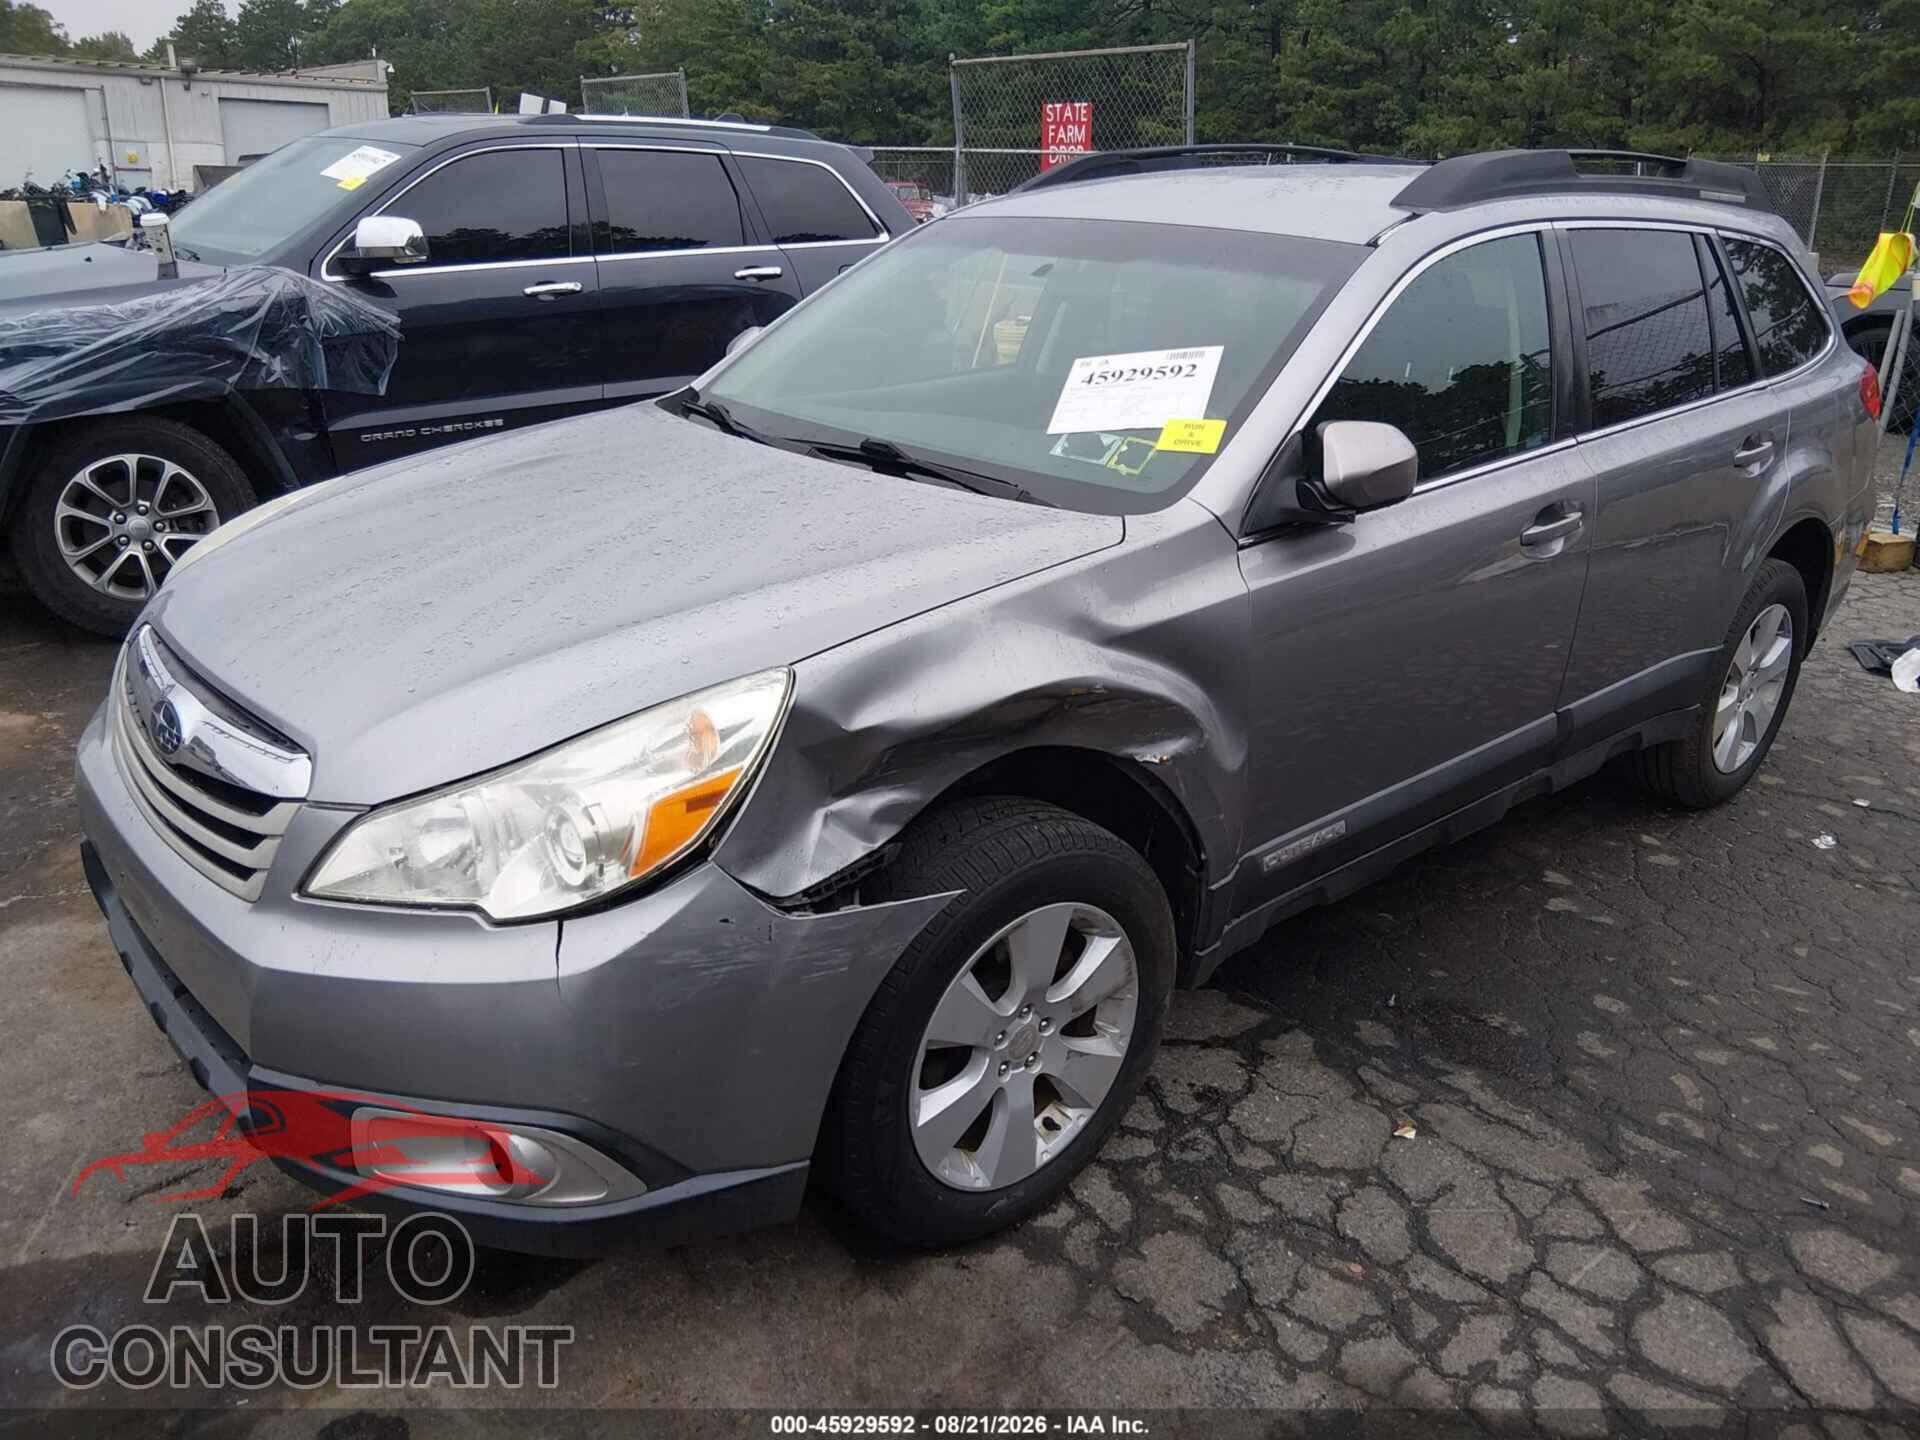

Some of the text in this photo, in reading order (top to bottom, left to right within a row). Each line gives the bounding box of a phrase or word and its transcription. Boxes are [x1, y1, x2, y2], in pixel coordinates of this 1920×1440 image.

[1046, 102, 1088, 122] STATE
[1048, 124, 1086, 143] FARM
[1081, 363, 1198, 385] 45929592
[360, 418, 504, 442] GRAND CHEROKEE
